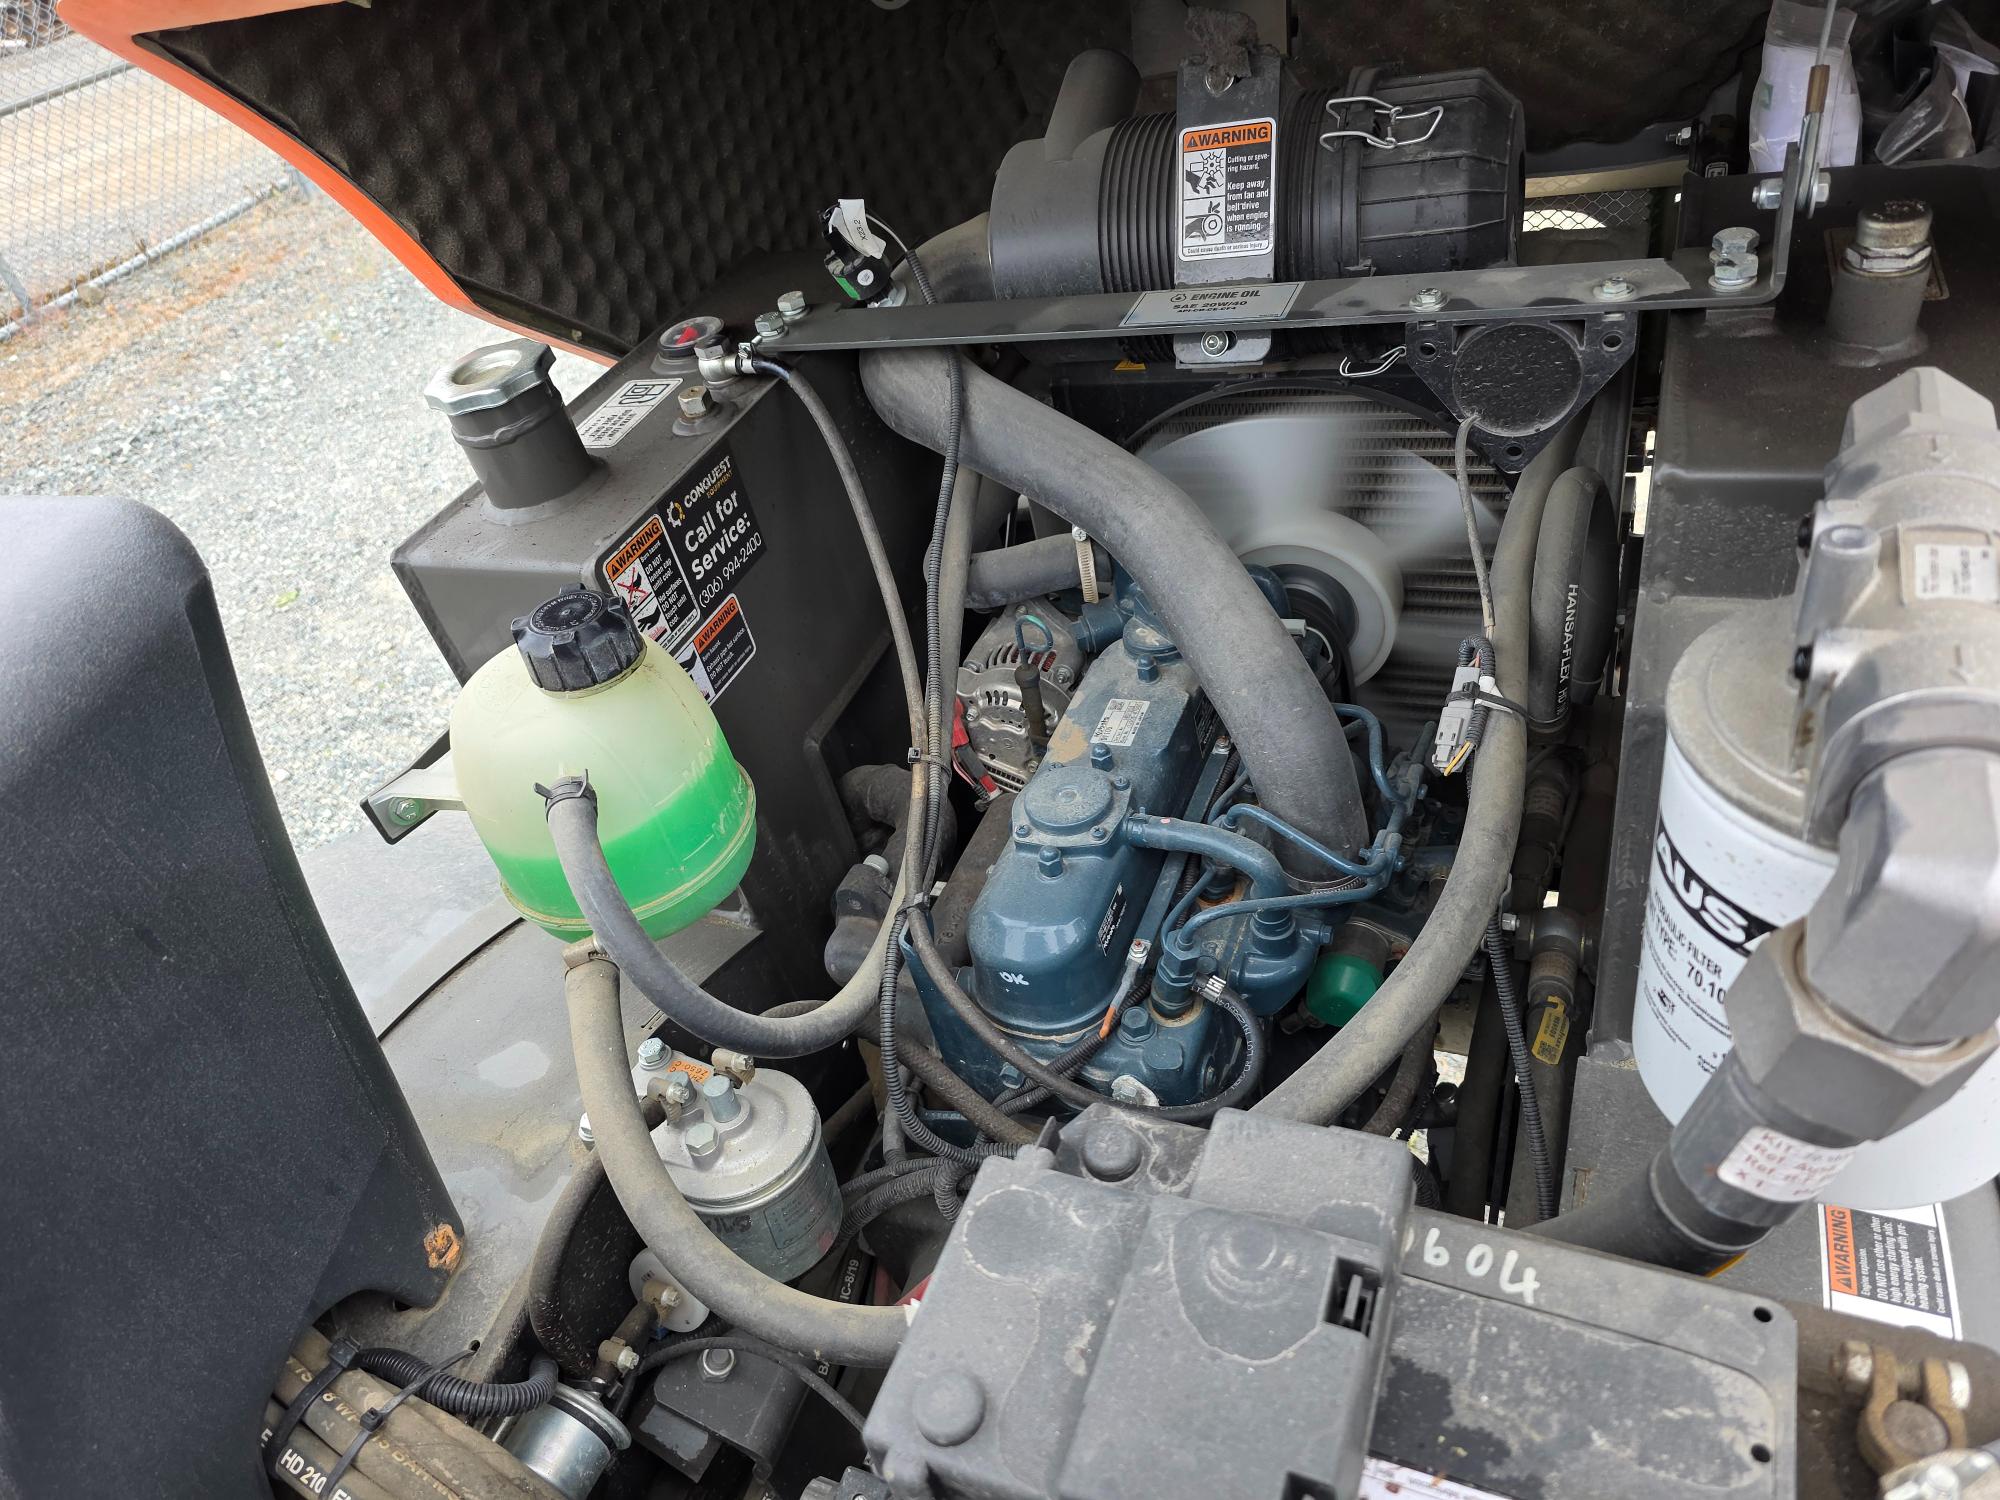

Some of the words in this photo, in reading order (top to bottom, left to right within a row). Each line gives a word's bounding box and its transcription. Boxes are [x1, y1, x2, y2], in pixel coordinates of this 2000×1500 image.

[1198, 126, 1268, 146] WARNING
[1228, 156, 1246, 164] Cutting
[1228, 165, 1238, 173] ring
[1227, 192, 1243, 201] from
[1244, 191, 1255, 200] fan
[1256, 190, 1269, 198] and
[1228, 181, 1245, 191] Keep
[1246, 180, 1265, 190] away
[1226, 202, 1240, 211] belt
[1241, 201, 1260, 210] drive
[1226, 213, 1244, 222] when
[1246, 211, 1268, 220] engine
[1226, 224, 1233, 232] is
[1234, 222, 1262, 232] running.
[1190, 292, 1239, 301] ENGINE
[1240, 290, 1261, 298] OIL
[684, 455, 731, 508] CONQUEST
[707, 470, 734, 498] EQUIPMENT
[685, 514, 716, 552] Call
[716, 489, 739, 521] for
[616, 523, 659, 567] WARNING
[692, 512, 751, 580] Service:
[644, 563, 653, 574] DO
[651, 553, 662, 567] NOT
[648, 566, 663, 582] loosen
[663, 558, 671, 568] cap
[700, 575, 724, 608] (306)
[722, 532, 762, 582] 994-2400
[652, 577, 663, 590] until
[662, 568, 673, 581] cool.
[657, 592, 666, 603] Hot
[665, 577, 682, 596] surfaces.
[661, 600, 669, 611] DO
[668, 591, 678, 604] NOT
[664, 604, 677, 619] touch
[702, 602, 735, 641] WARNING
[1560, 584, 1578, 684] HANSA-FLEX
[709, 670, 716, 679] DO
[715, 661, 723, 673] NOT
[1656, 831, 1770, 950] AUS
[1687, 941, 1722, 979] FILTER
[999, 971, 1029, 986] OK
[1870, 1216, 1881, 1232] other
[1883, 1222, 1893, 1236] aids.
[1897, 1222, 1908, 1235] pre-
[1830, 1209, 1850, 1274] WARNING
[1874, 1232, 1882, 1240] or
[1897, 1235, 1908, 1249] with
[1873, 1241, 1884, 1257] ether
[1885, 1236, 1896, 1261] starting
[1929, 1243, 1938, 1260] serious
[1859, 1248, 1869, 1274] explosion.
[1876, 1258, 1885, 1271] use
[1899, 1249, 1913, 1280] equipped
[1914, 1257, 1926, 1282] system.
[1875, 1271, 1886, 1287] NOT
[1889, 1262, 1899, 1286] energy
[1932, 1267, 1941, 1281] death
[1860, 1275, 1871, 1295] Engine
[1876, 1288, 1888, 1299] DO
[1889, 1286, 1902, 1302] high
[1903, 1281, 1916, 1305] Engine
[1935, 1281, 1943, 1297] cause
[1917, 1282, 1928, 1309] heating
[1936, 1297, 1945, 1313] Could
[280, 1449, 305, 1475] HD
[300, 1466, 328, 1494] 210
